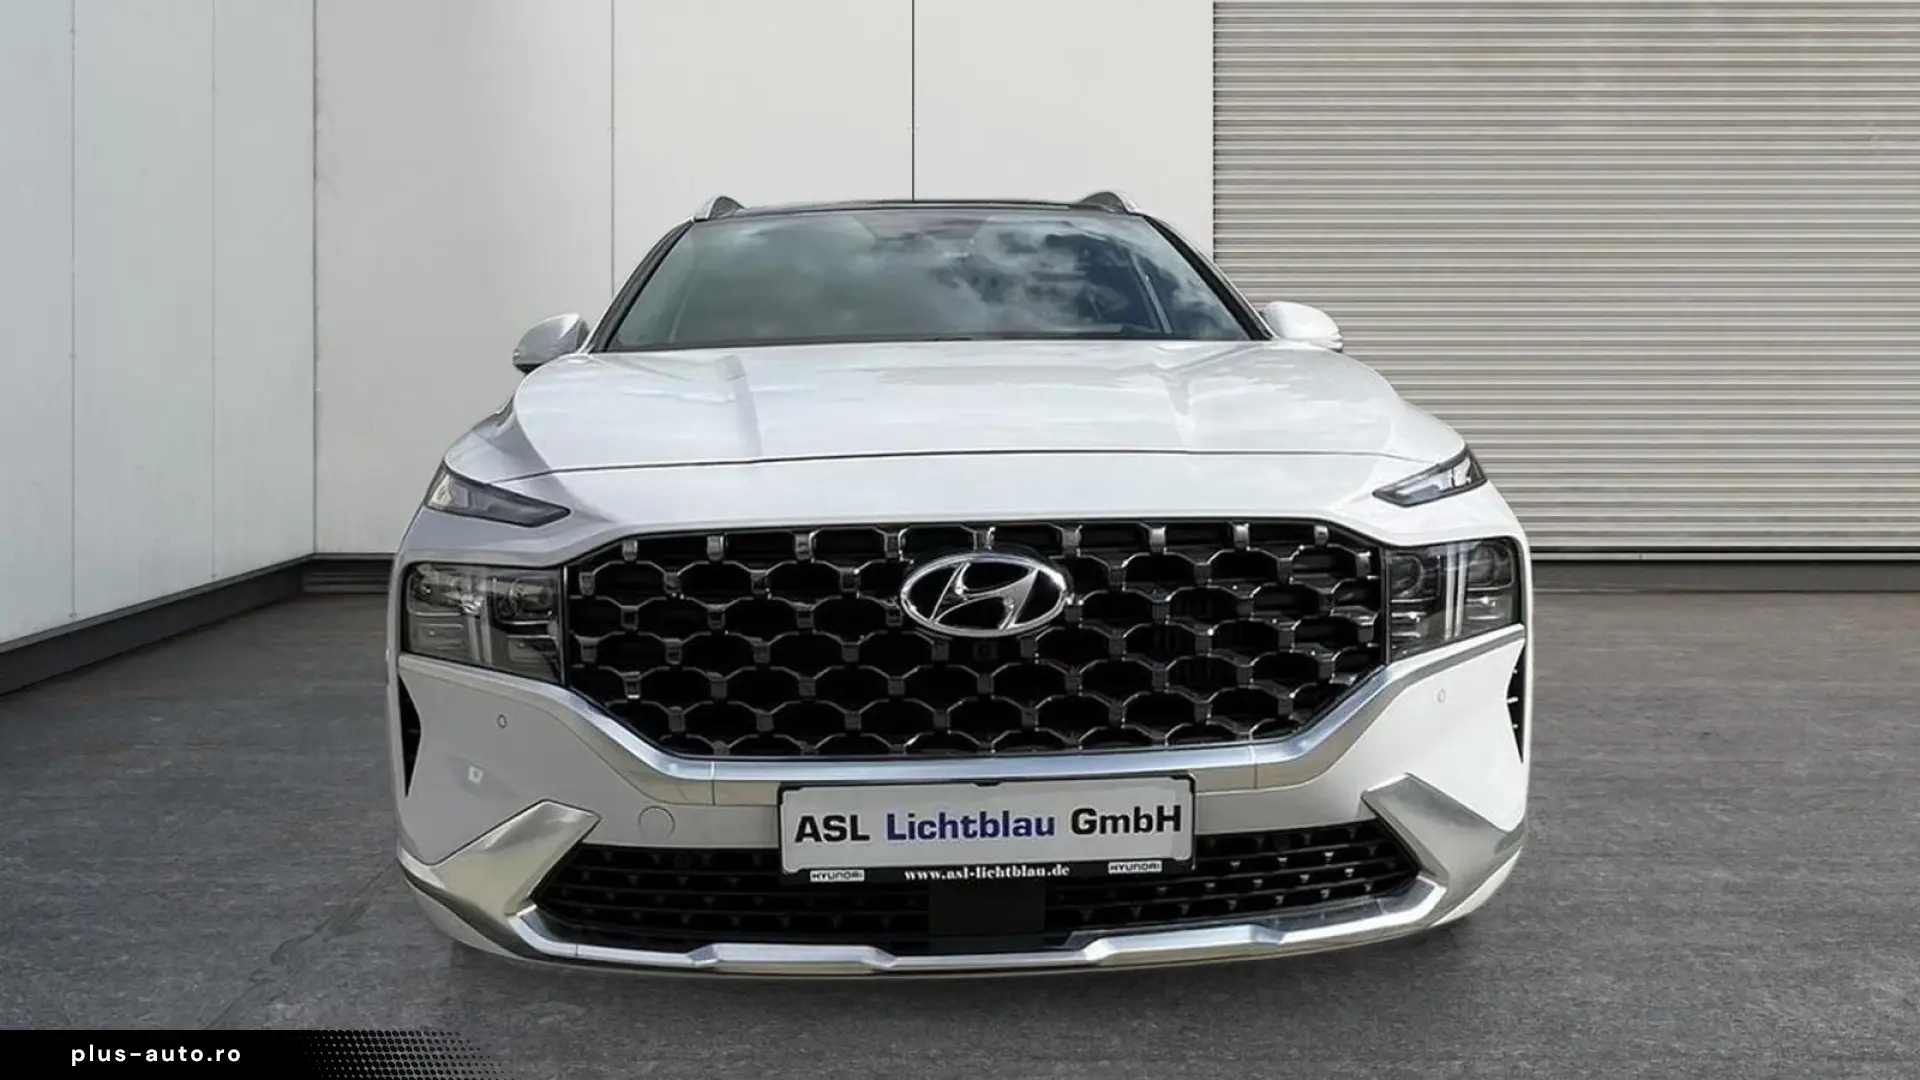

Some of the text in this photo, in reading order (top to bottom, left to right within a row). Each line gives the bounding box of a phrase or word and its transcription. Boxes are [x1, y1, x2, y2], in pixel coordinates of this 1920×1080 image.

[795, 804, 1182, 843] ASL Lichtblau GmbH
[903, 864, 1070, 881] www.asl-lichtblau.de
